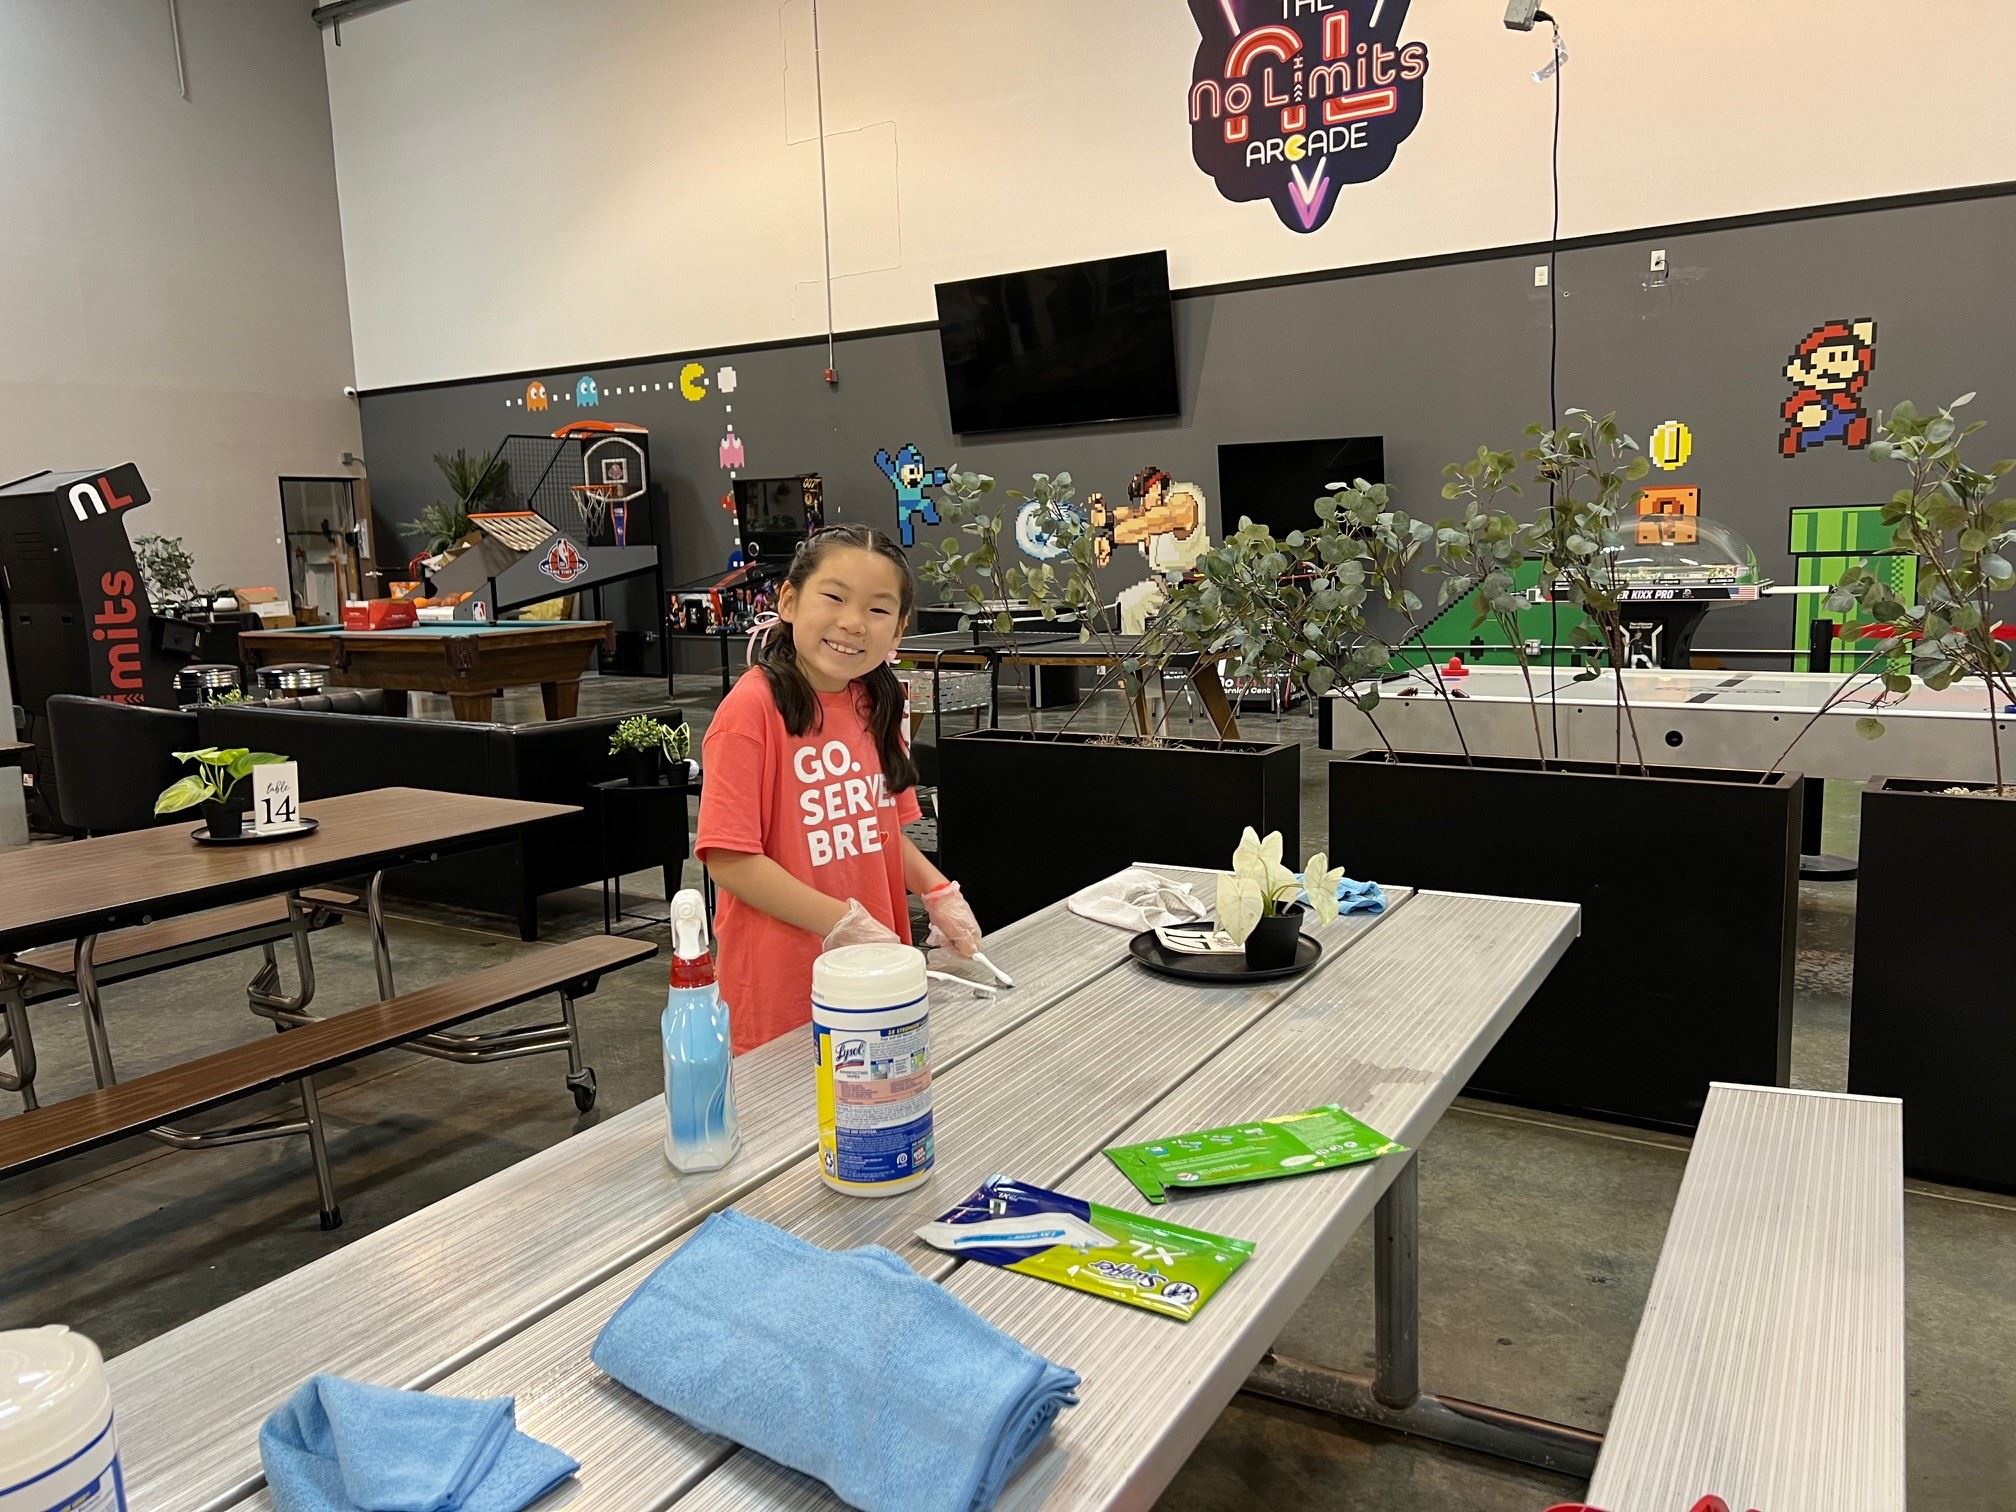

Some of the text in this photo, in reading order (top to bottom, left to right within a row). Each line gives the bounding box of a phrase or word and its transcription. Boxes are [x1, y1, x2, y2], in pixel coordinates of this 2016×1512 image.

[1246, 121, 1369, 168] ARCADE
[1631, 588, 1653, 600] KIXX
[793, 740, 862, 784] GO.
[266, 780, 290, 795] table
[260, 794, 297, 825] 14
[835, 1042, 865, 1061] Lysol
[1128, 1238, 1189, 1267] XL
[1088, 1259, 1168, 1288] Swiffer
